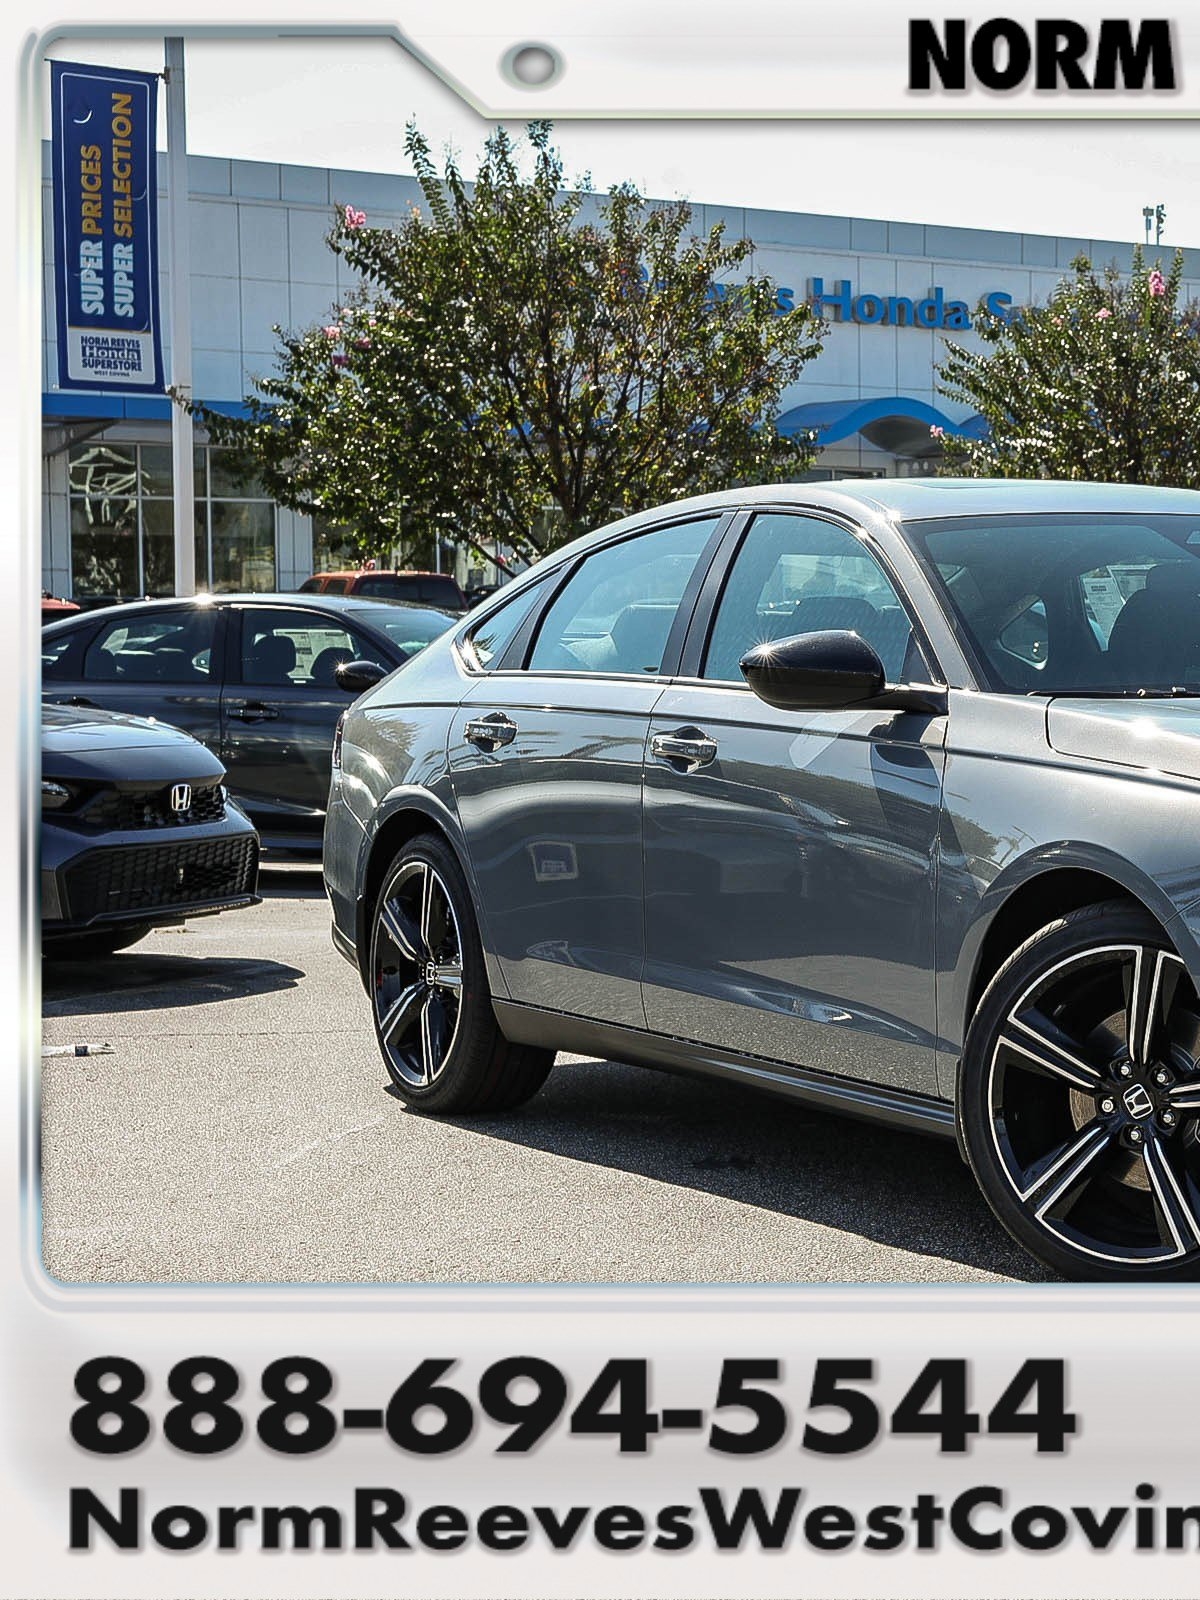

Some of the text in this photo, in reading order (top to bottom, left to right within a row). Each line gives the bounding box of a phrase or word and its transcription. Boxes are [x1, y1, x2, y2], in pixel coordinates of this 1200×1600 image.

[112, 93, 134, 318] SUPER SELECTION
[80, 145, 104, 315] SUPER PRICES
[810, 277, 972, 330] Honda
[81, 336, 140, 348] NORM REEVES
[86, 346, 138, 360] Honda
[82, 359, 142, 371] SUPERSTORE
